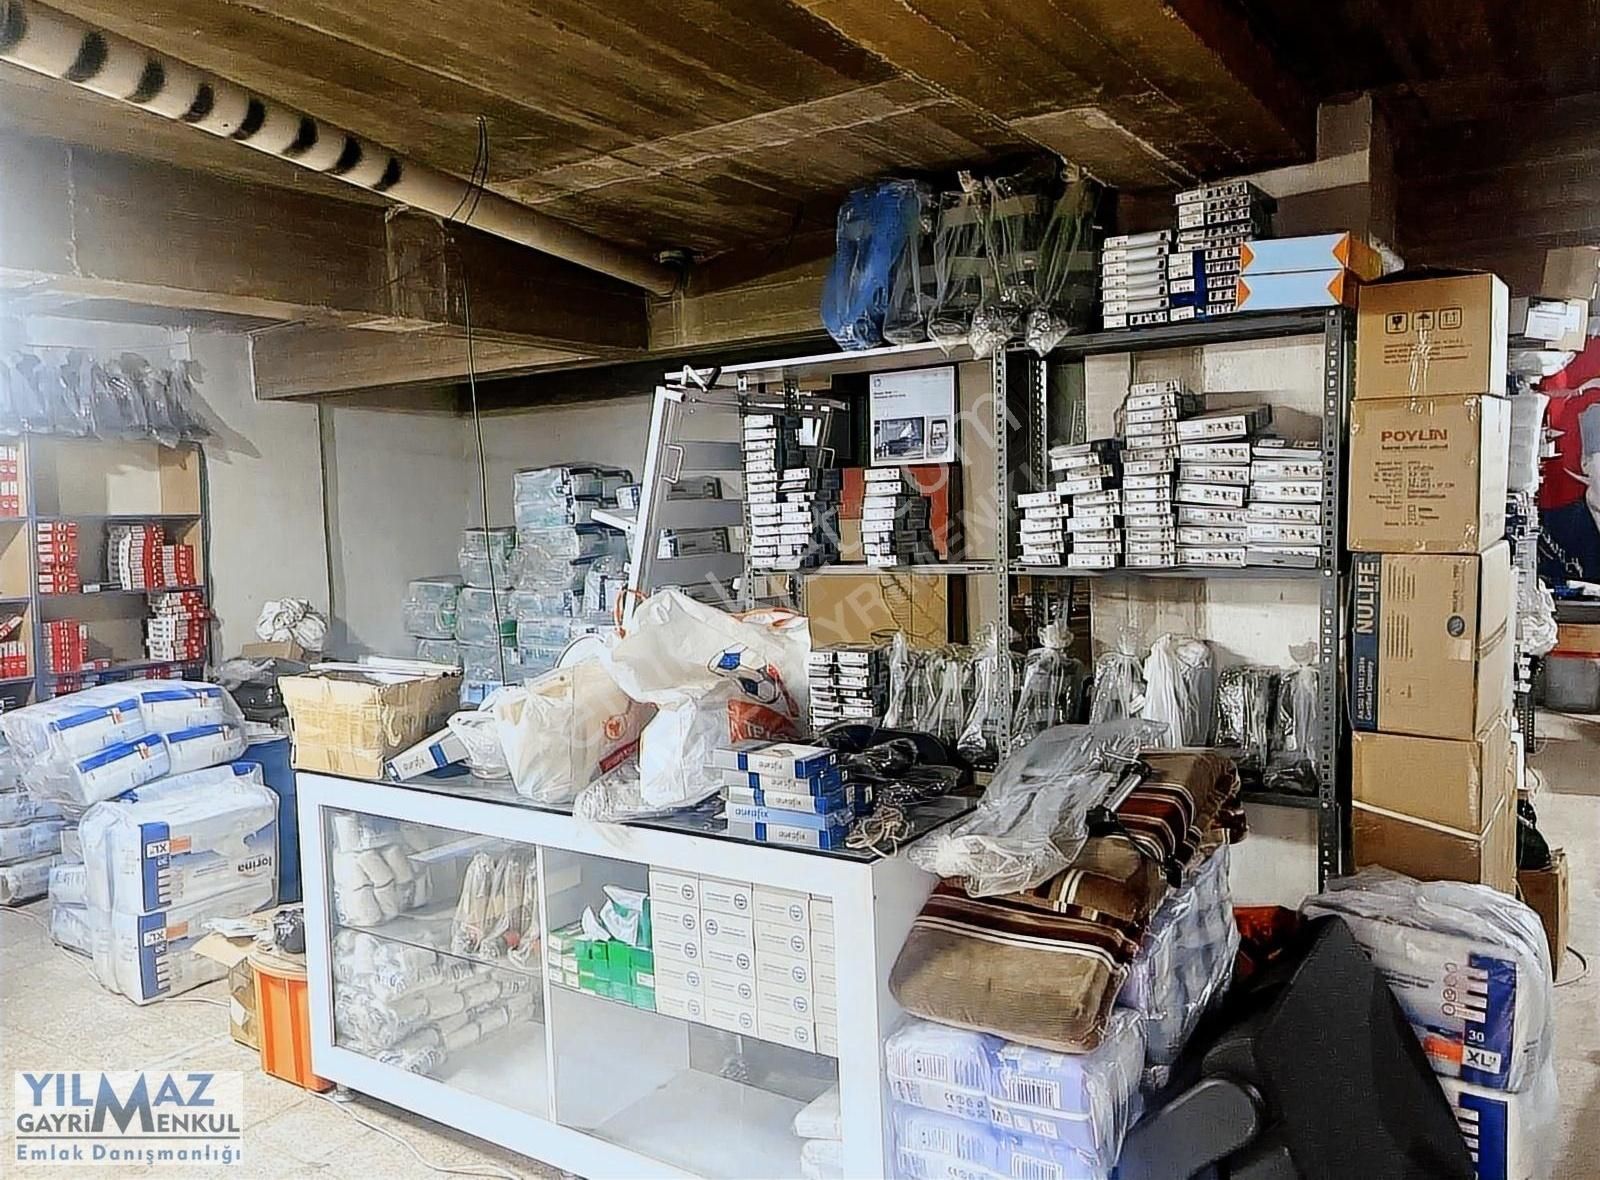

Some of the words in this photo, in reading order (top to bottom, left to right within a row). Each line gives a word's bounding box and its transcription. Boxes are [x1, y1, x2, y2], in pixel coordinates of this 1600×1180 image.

[1381, 429, 1448, 442] POYLIN
[1356, 561, 1375, 634] NULIFE
[735, 808, 769, 820] aurafix
[1468, 1029, 1485, 1043] 30
[1467, 1049, 1492, 1067] XL
